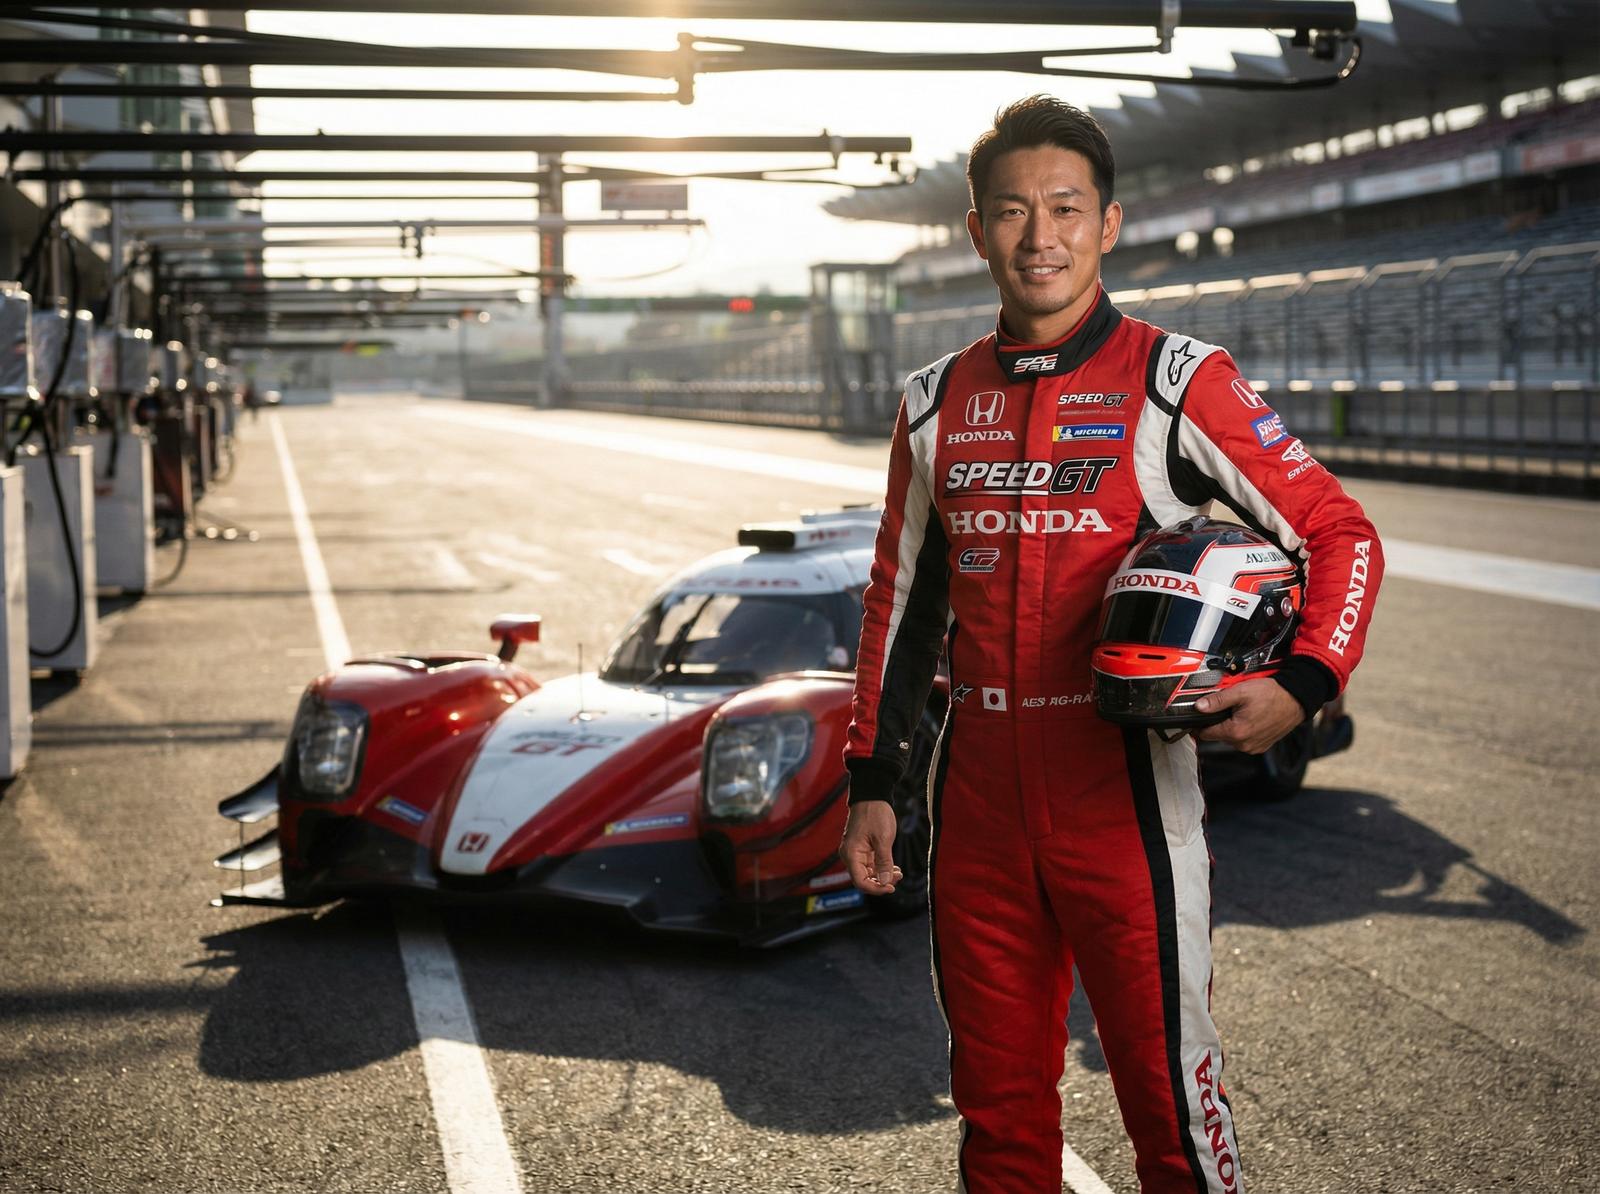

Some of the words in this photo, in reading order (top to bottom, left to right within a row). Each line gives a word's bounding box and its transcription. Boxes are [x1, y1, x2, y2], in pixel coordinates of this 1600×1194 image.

[1058, 393, 1104, 405] SPEED
[1103, 393, 1130, 407] GT
[946, 431, 1015, 444] HONDA
[1074, 428, 1119, 436] MICHELIN
[946, 462, 1053, 489] SPEED
[1050, 457, 1118, 494] GT
[948, 508, 1112, 535] HONDA
[1114, 574, 1202, 596] HONDA
[1328, 540, 1372, 656] HONDA
